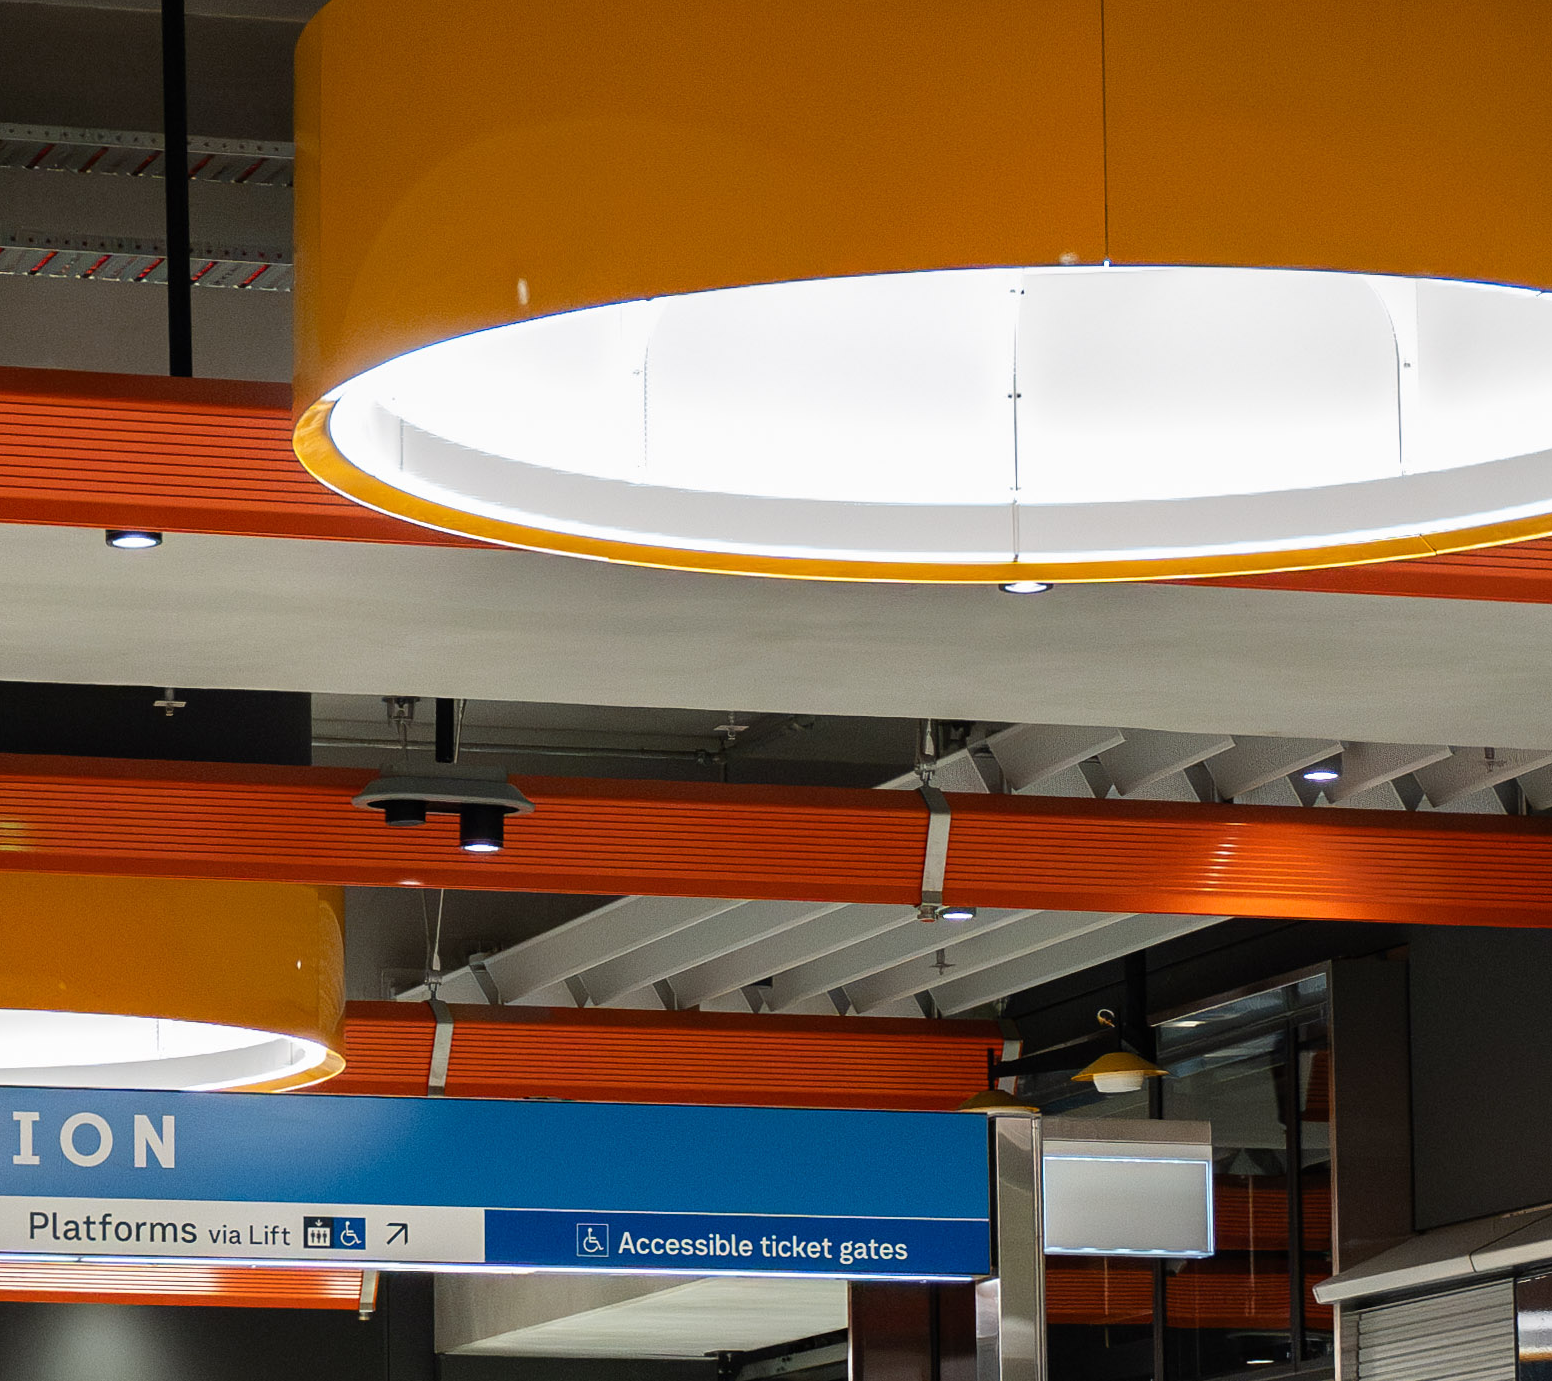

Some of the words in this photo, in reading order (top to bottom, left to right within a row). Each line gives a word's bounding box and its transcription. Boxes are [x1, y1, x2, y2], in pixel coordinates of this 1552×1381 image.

[29, 1211, 198, 1244] Platforms
[208, 1224, 242, 1245] via
[249, 1225, 291, 1246] Lift
[618, 1231, 753, 1257] Accessible
[760, 1234, 833, 1259] ticket
[839, 1238, 908, 1265] gates
